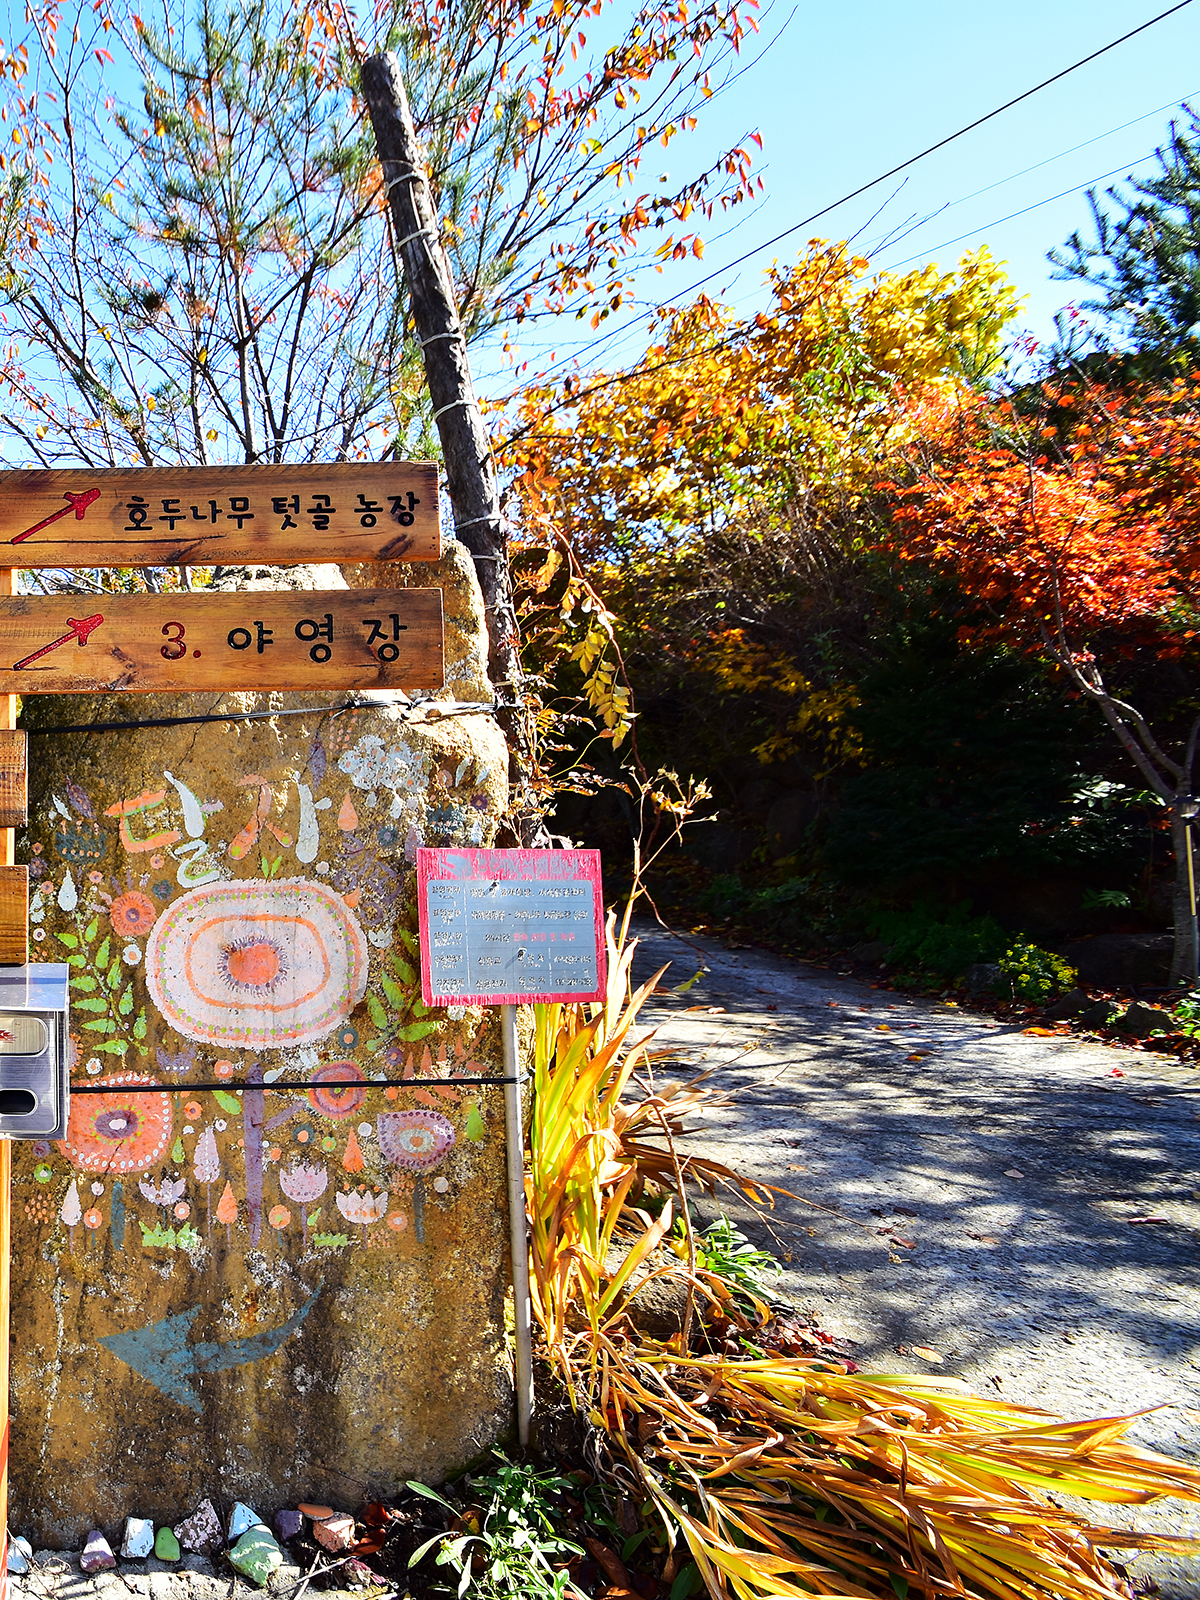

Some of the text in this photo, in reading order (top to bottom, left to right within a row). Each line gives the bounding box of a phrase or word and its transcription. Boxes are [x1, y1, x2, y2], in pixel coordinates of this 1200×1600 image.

[123, 491, 421, 532] 호두나무 텃골 농장
[160, 613, 408, 664] 3. 야영장
